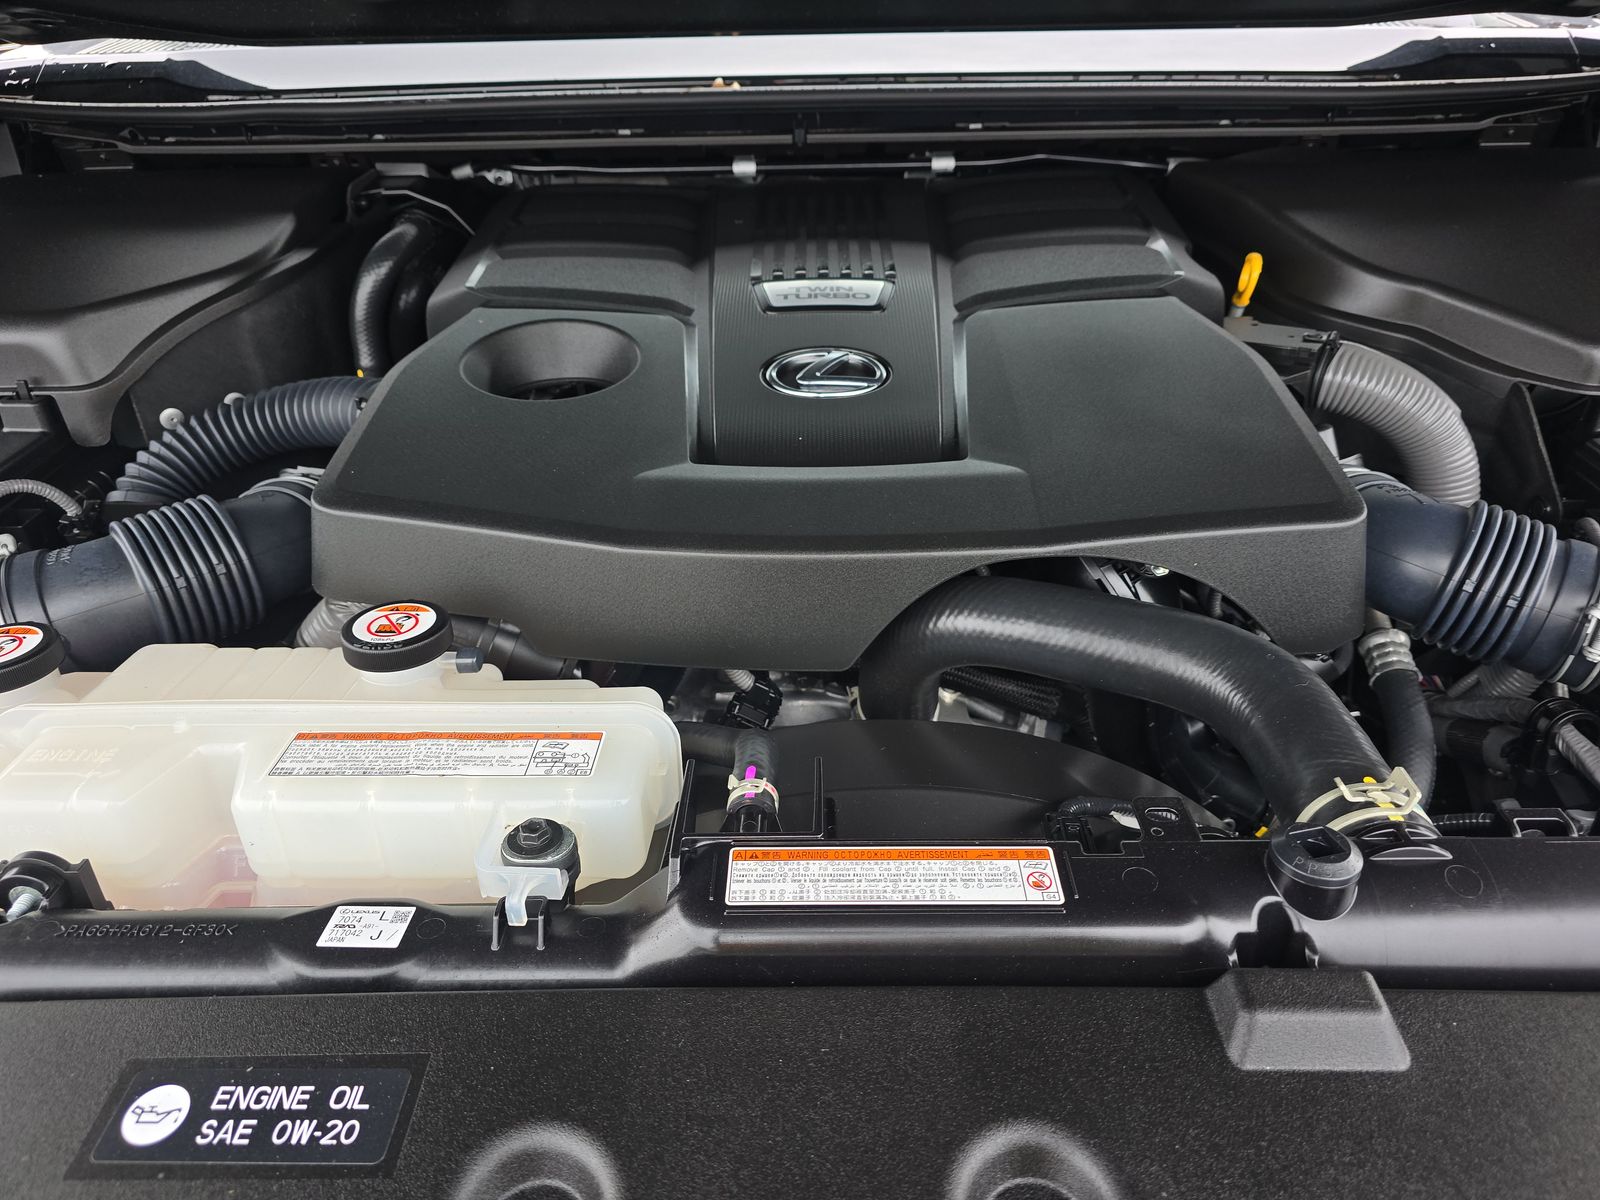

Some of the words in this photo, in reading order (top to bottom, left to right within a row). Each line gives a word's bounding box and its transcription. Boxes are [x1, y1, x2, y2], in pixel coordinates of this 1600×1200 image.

[775, 292, 871, 300] TURBO
[787, 851, 829, 859] WARNING
[897, 851, 968, 859] AVERTISSEMENT
[379, 910, 389, 921] L
[328, 929, 363, 937] 717042
[370, 930, 383, 941] J
[210, 1085, 315, 1110] ENGINE
[329, 1085, 370, 1110] OIL
[195, 1119, 258, 1145] SAE
[271, 1119, 361, 1145] 0W-20
